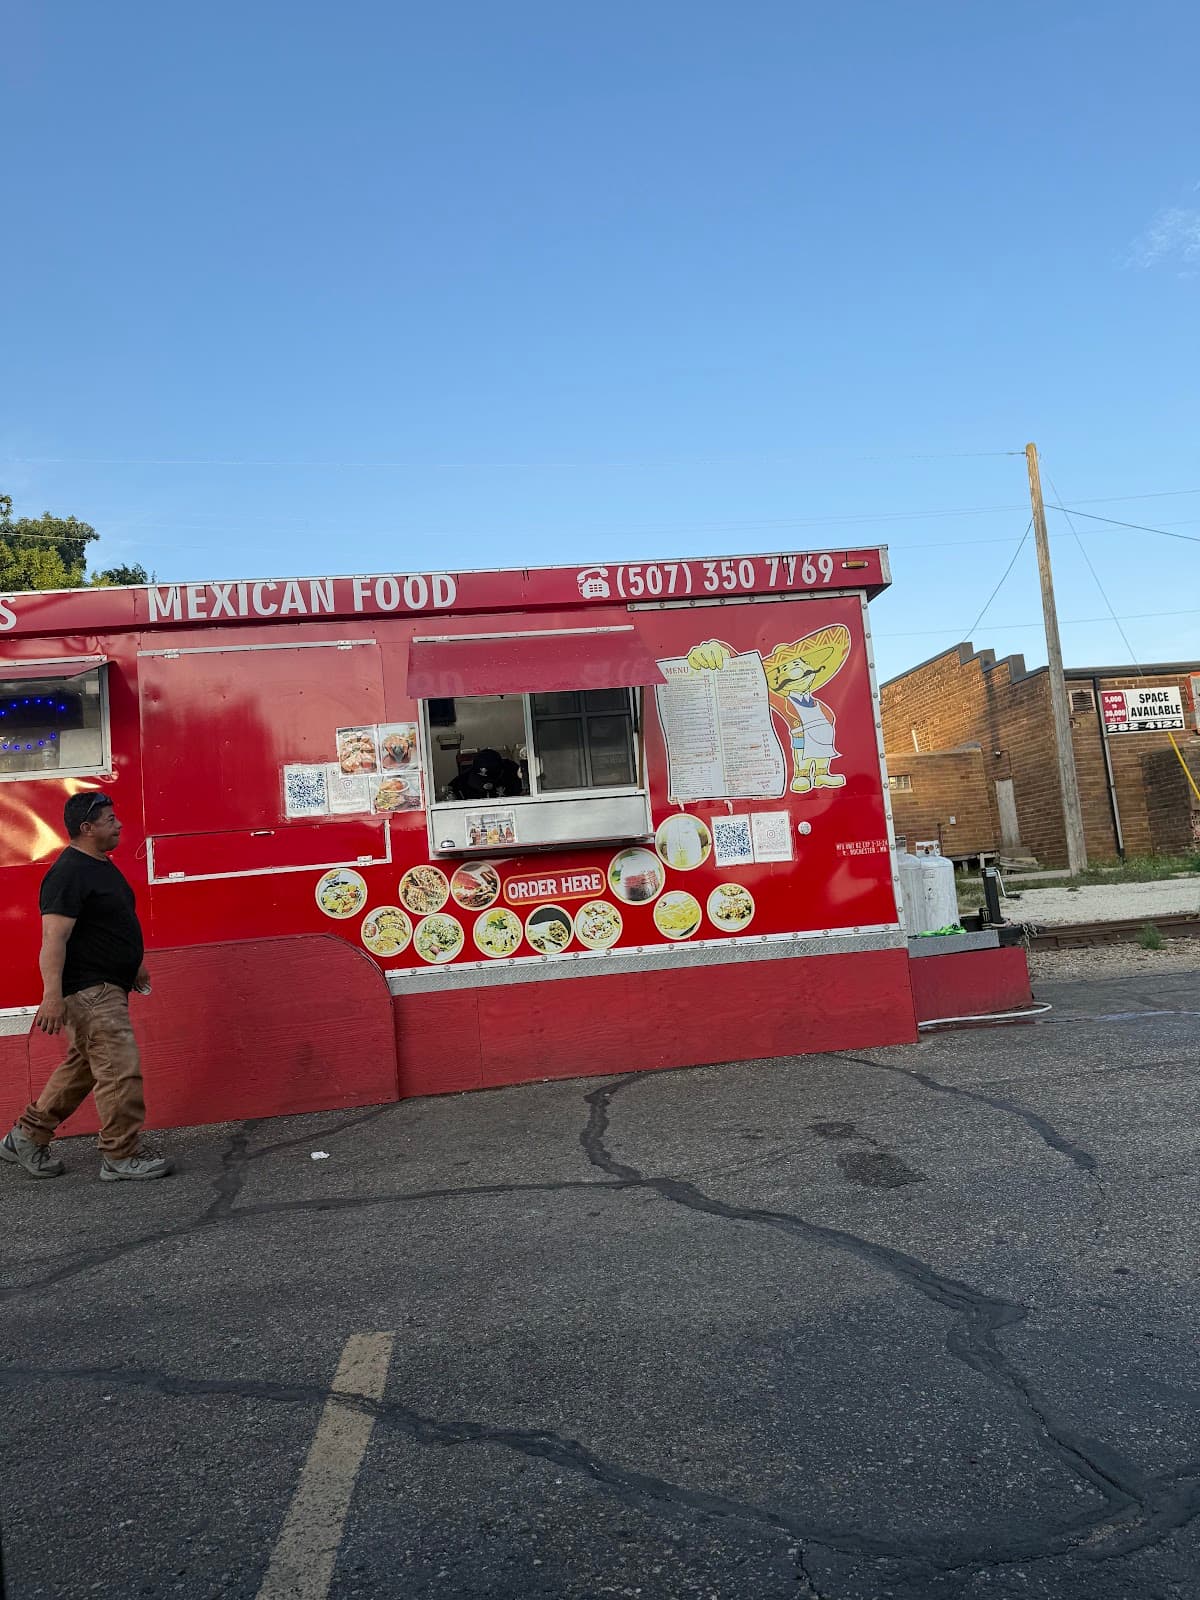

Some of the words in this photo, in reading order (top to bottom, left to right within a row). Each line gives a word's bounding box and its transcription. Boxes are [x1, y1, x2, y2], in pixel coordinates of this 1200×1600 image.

[616, 563, 692, 598] (507)
[703, 559, 755, 592] 350
[765, 554, 834, 587] 7769
[148, 578, 336, 622] MEXICAN
[353, 574, 457, 613] FOOD
[665, 666, 689, 675] MENU
[1139, 692, 1169, 703] SPACE
[1131, 704, 1181, 717] AVAILABLE
[1107, 720, 1182, 731] 282-4124
[507, 879, 558, 899] ORDER
[561, 874, 601, 893] HERE
